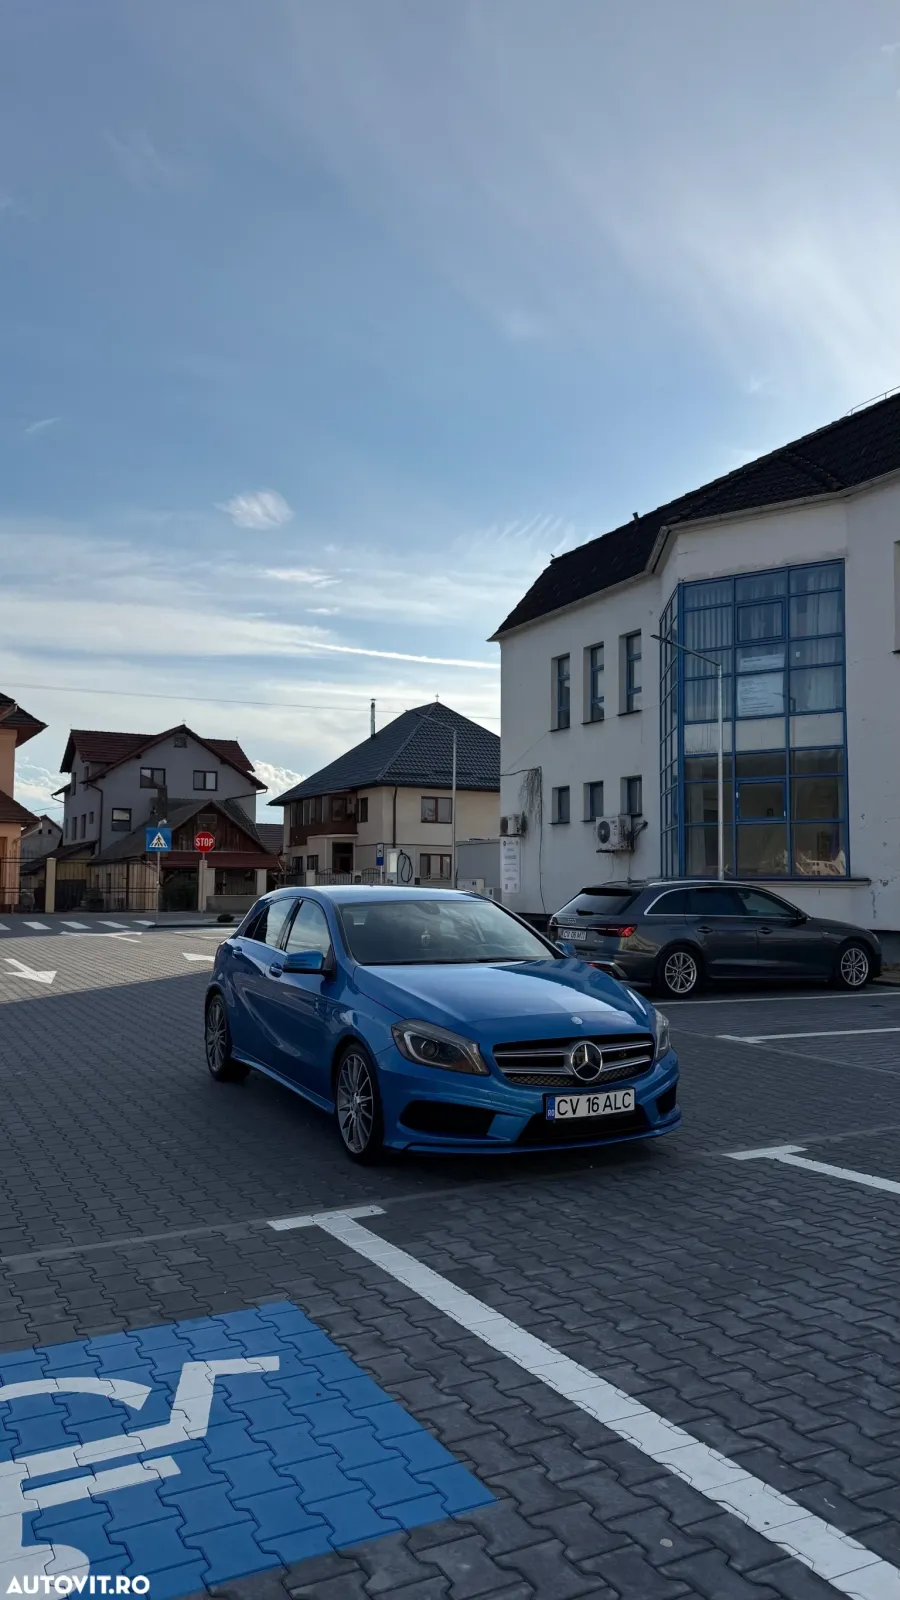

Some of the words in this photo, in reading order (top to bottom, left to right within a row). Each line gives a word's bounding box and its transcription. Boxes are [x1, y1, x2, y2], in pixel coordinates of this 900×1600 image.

[196, 838, 213, 846] STOP
[557, 1098, 580, 1116] CV
[586, 1096, 599, 1113] 16
[602, 1092, 631, 1112] ALC
[547, 1109, 555, 1117] RO
